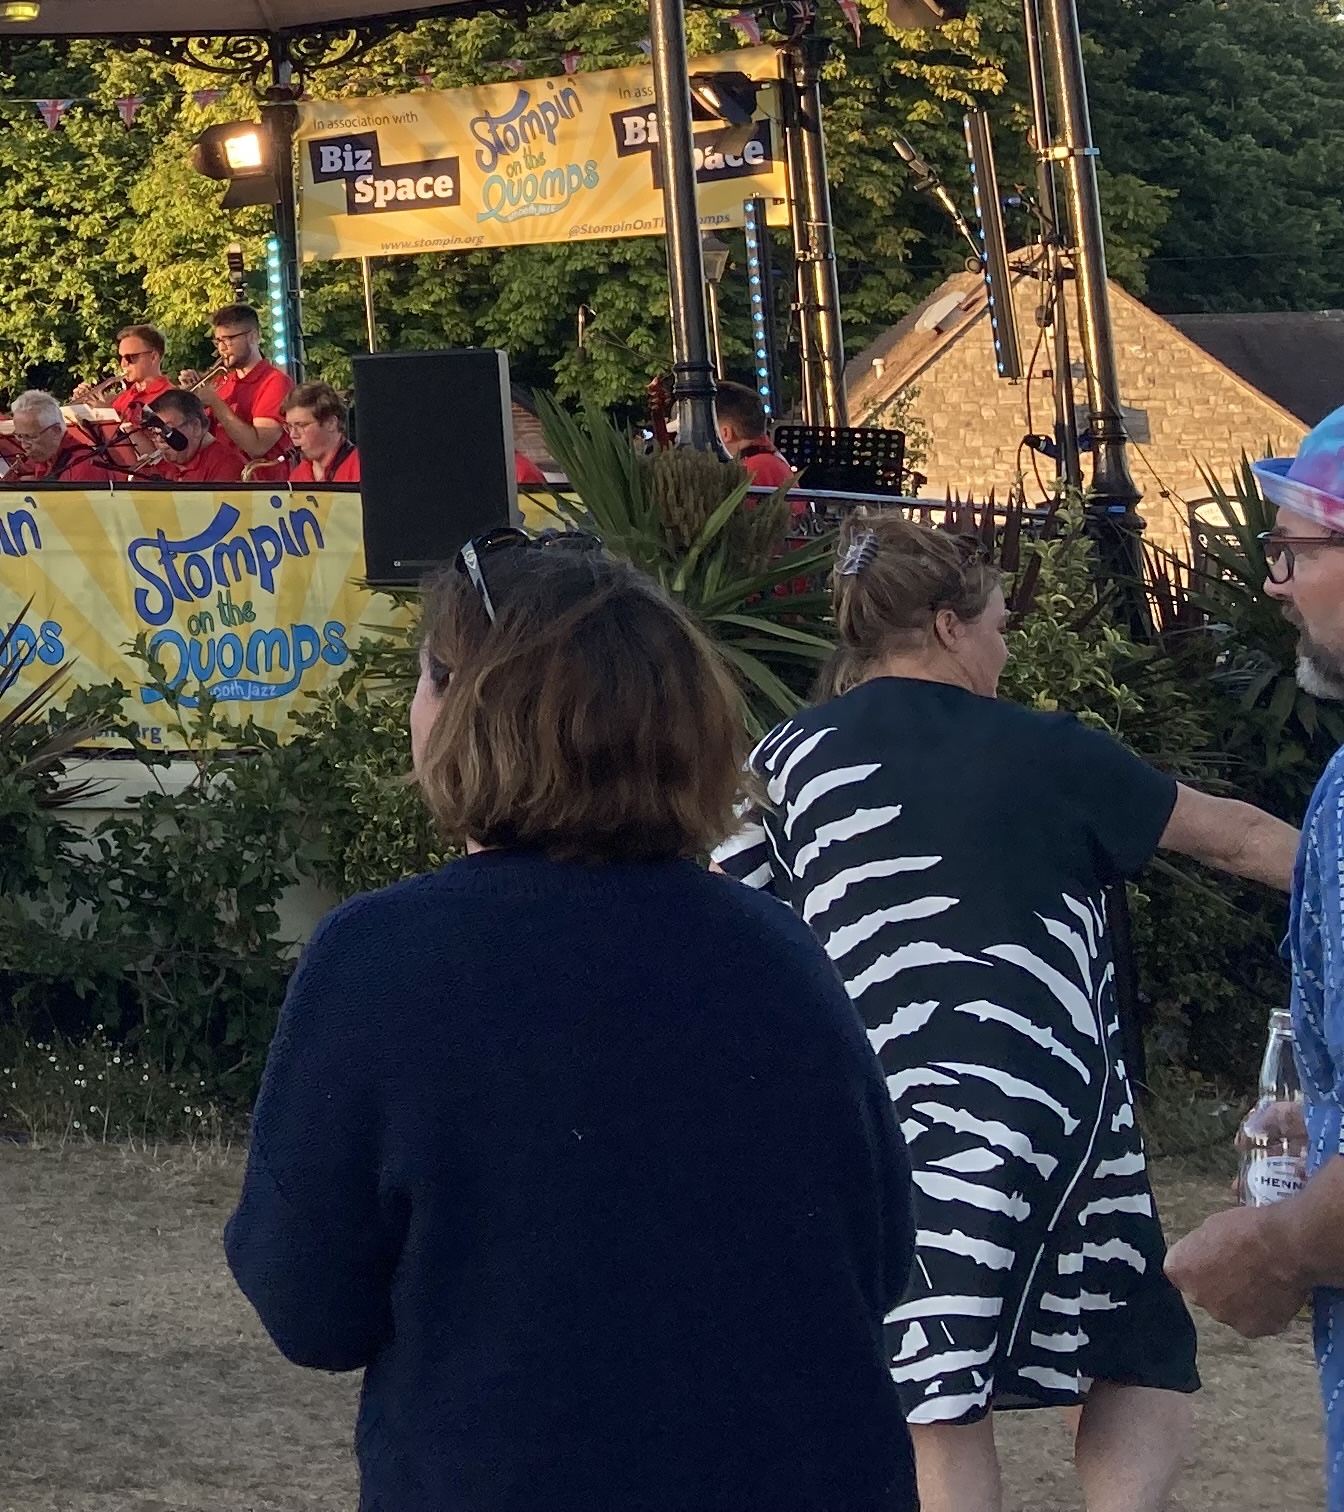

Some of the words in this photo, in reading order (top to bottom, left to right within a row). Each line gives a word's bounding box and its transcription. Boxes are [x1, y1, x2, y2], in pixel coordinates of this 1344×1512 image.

[619, 88, 632, 99] In
[314, 119, 324, 129] In
[327, 115, 390, 128] association
[392, 111, 418, 124] with
[622, 112, 659, 146] Bi
[319, 144, 373, 173] Biz
[506, 161, 522, 178] on
[523, 145, 546, 170] the
[354, 174, 454, 208] Space
[477, 160, 599, 223] Quomps
[380, 235, 485, 251] www.stompin.org
[127, 495, 325, 626] Stompin'
[187, 611, 215, 636] on
[216, 589, 257, 627] the
[140, 621, 348, 708] Quomps
[1260, 1175, 1304, 1190] HENN
